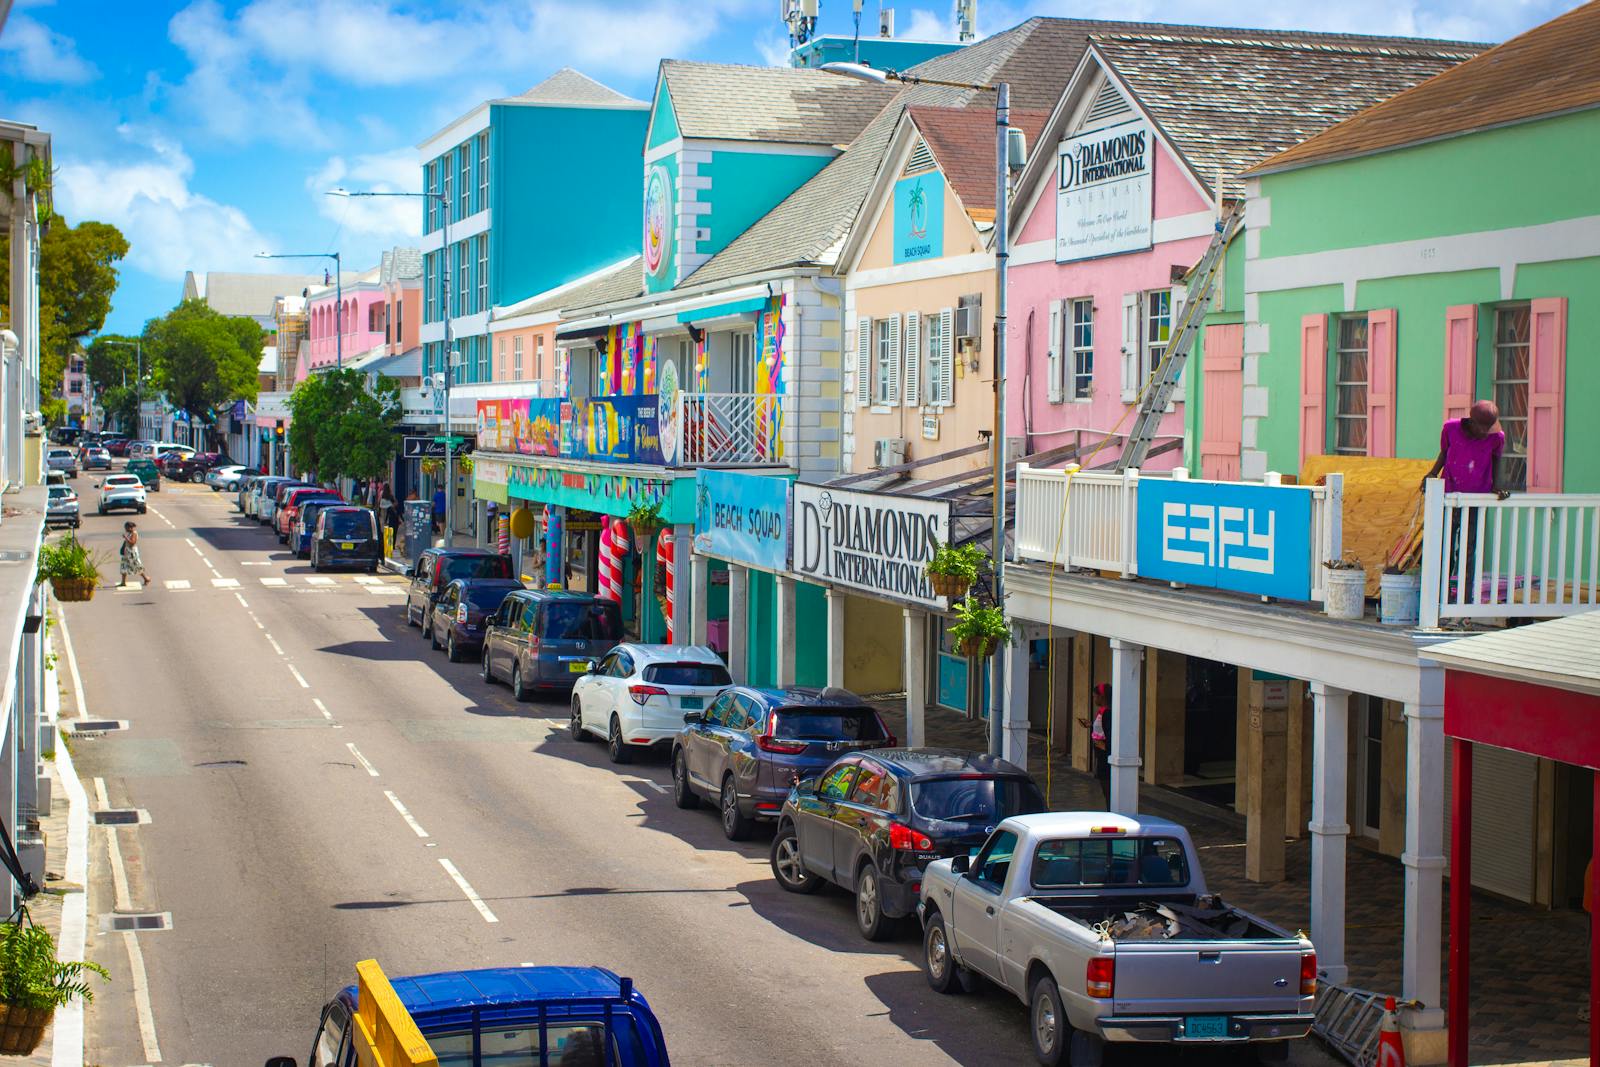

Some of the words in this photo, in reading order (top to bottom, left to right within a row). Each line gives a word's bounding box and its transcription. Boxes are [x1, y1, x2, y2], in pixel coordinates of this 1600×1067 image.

[1082, 130, 1145, 168] DIAMONDS
[1082, 157, 1145, 183] INTERNATIONAL
[1066, 182, 1142, 207] BAHAMAS
[905, 247, 917, 258] BEACH
[917, 245, 930, 257] SQUAD
[715, 503, 743, 532] BEACH
[749, 509, 782, 542] SQUAD
[833, 502, 939, 563] DIAMONDS
